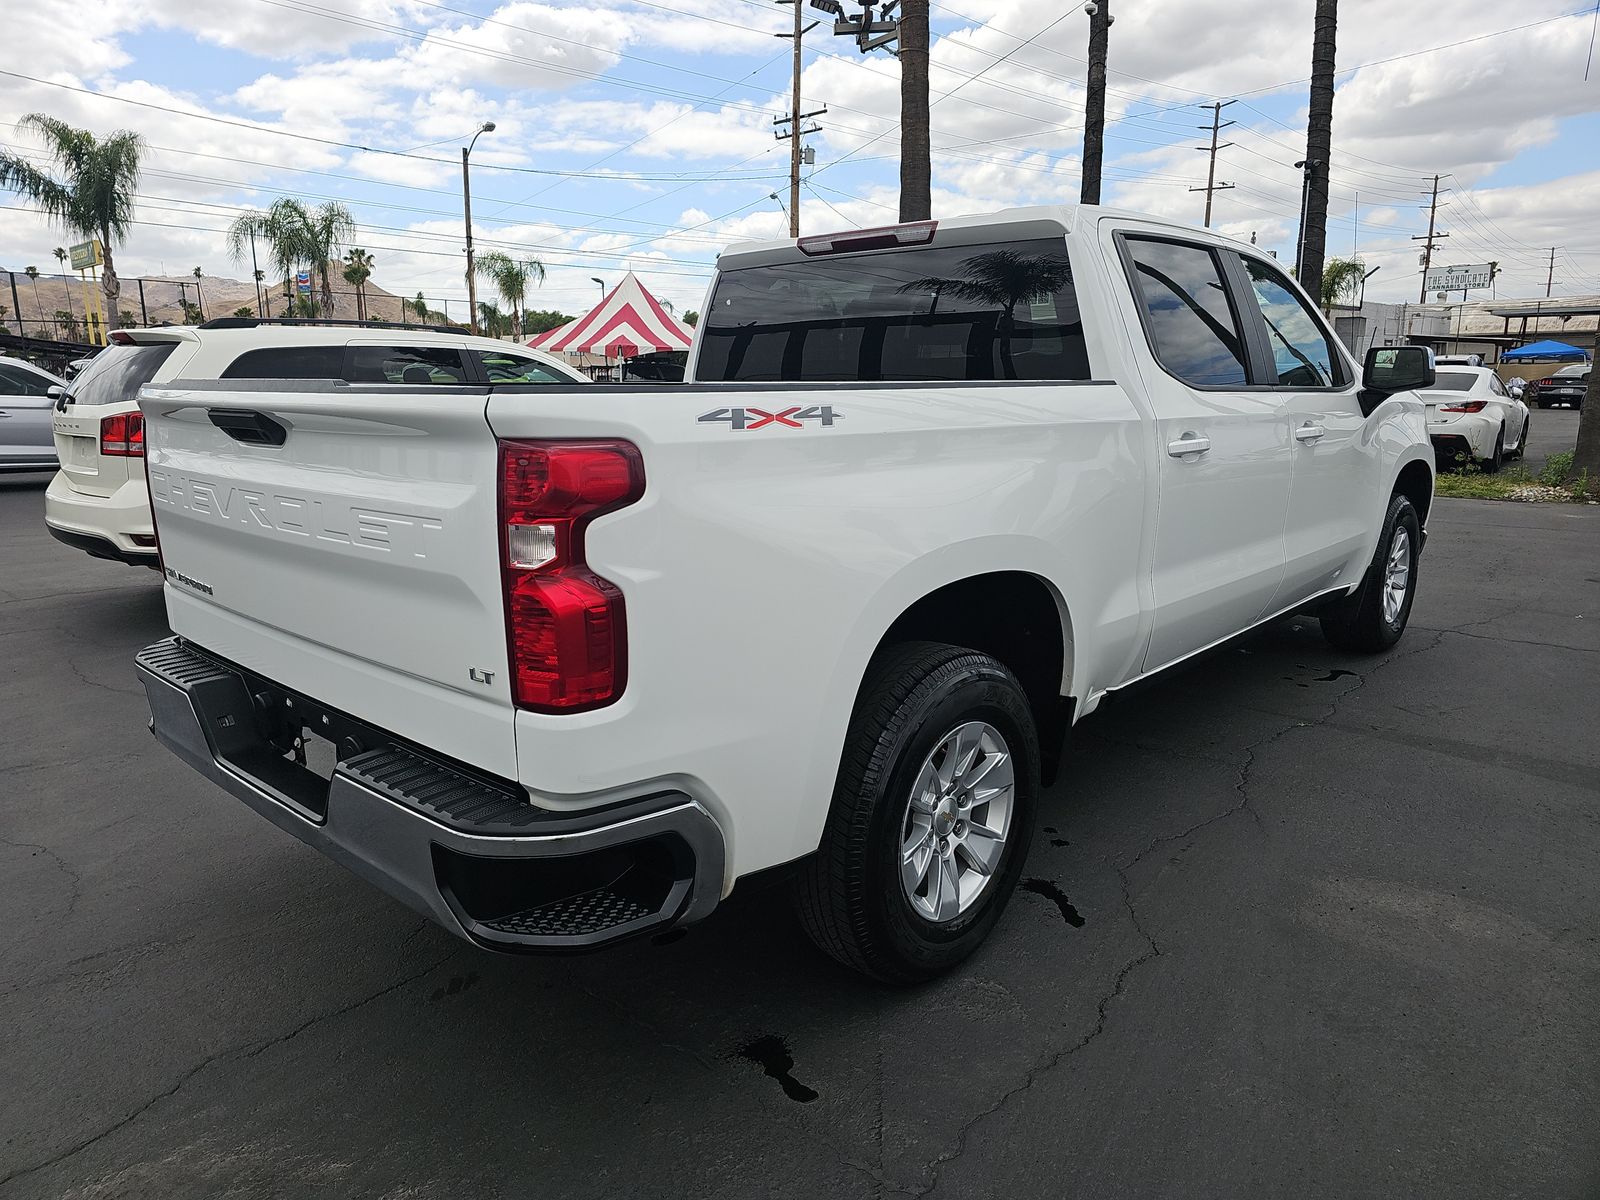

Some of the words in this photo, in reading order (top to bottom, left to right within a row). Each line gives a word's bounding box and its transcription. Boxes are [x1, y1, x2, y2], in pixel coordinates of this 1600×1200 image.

[1427, 276, 1442, 285] THE
[1445, 273, 1488, 284] SYNDICATE
[151, 470, 443, 558] CHEVROLET
[469, 667, 495, 685] LT
